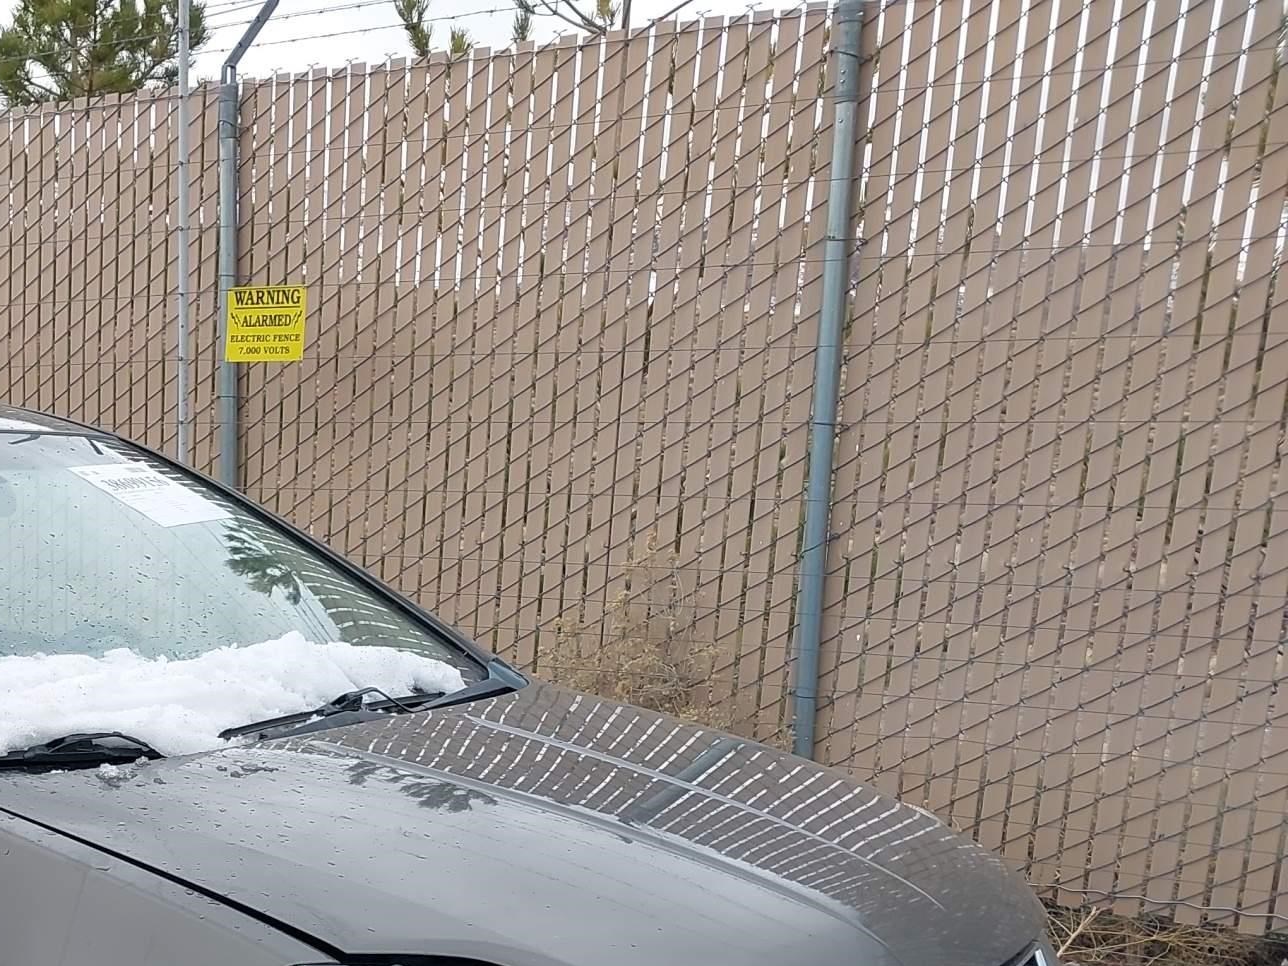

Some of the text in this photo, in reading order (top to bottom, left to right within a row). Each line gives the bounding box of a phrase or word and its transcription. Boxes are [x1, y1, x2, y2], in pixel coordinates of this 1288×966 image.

[234, 289, 301, 306] WARNING
[241, 314, 292, 327] ALARMED
[230, 333, 301, 343] ELECTRIC FENCE
[263, 345, 290, 354] VOLTS
